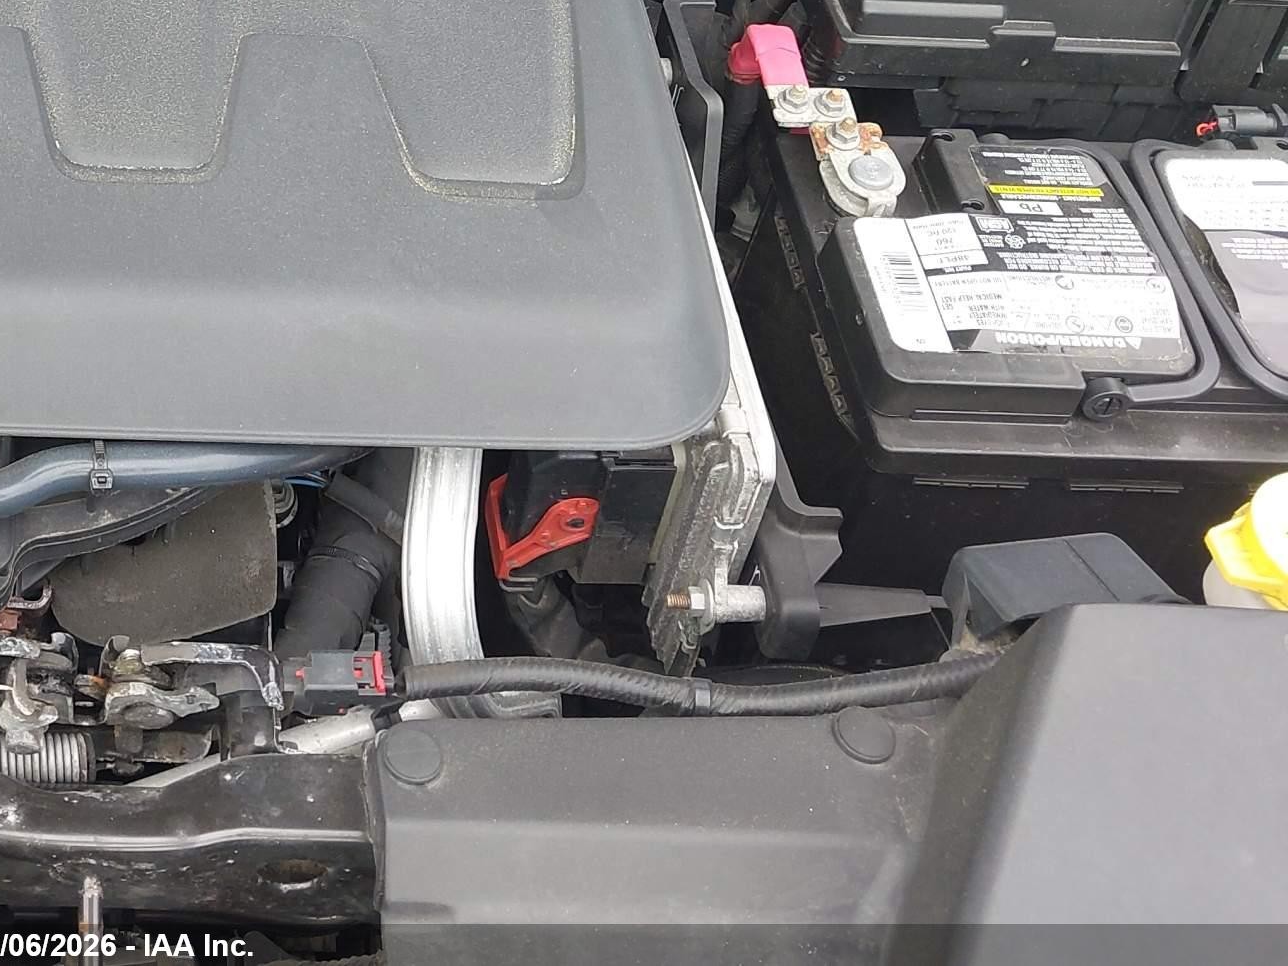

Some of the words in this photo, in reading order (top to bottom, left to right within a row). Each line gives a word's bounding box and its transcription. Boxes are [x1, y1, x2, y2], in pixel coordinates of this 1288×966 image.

[1019, 202, 1044, 212] Pb
[958, 294, 974, 302] HELP
[975, 293, 1003, 301] MEDICAL
[993, 331, 1126, 348] DANGER/POISON
